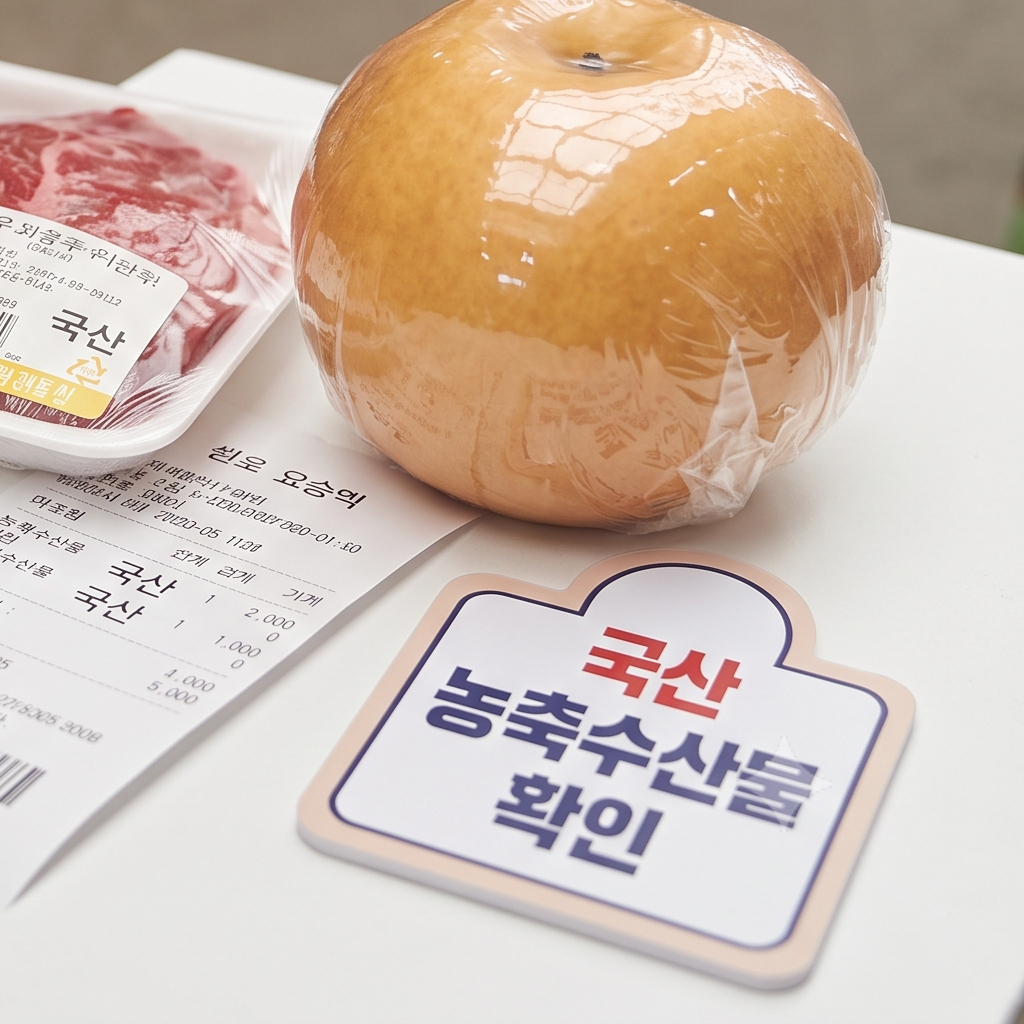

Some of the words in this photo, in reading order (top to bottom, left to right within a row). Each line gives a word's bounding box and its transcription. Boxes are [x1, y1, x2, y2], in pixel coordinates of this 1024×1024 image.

[52, 308, 126, 356] 국산
[74, 585, 145, 625] 국산
[108, 560, 177, 598] 국산
[582, 626, 743, 719] 국산
[424, 666, 820, 830] 농축수산물
[493, 771, 664, 876] 확인
